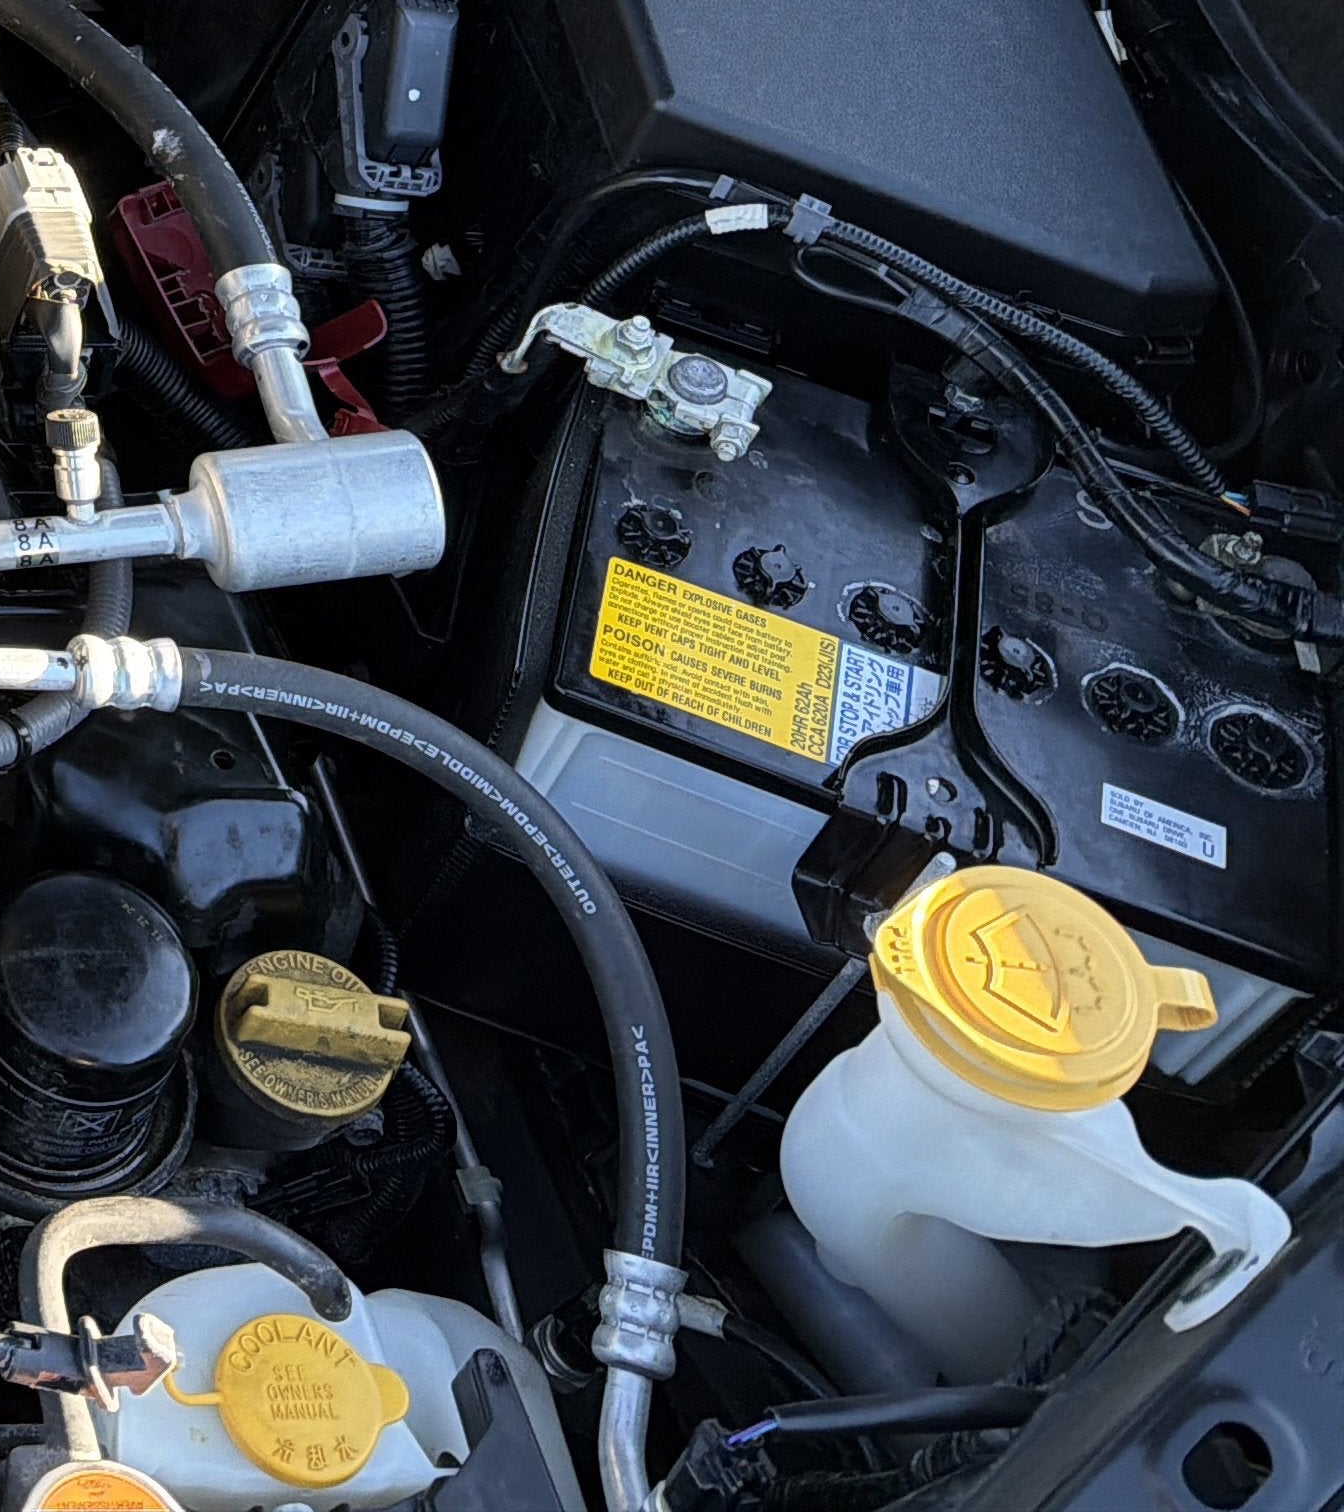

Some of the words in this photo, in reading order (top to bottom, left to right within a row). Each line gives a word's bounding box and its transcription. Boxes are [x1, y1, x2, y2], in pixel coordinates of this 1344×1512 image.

[18, 533, 32, 551] 8
[38, 532, 54, 549] A
[20, 554, 32, 567] 8
[39, 553, 54, 566] A
[613, 562, 678, 596] DANGER
[682, 589, 732, 615] EXPLOSIVE
[735, 608, 767, 628] GASES
[602, 623, 665, 657] POISON
[670, 650, 708, 673] CAUSES
[710, 665, 746, 687] SEVERE
[749, 679, 782, 700] BURNS
[617, 612, 641, 630] KEEP
[644, 622, 668, 640] VENT
[670, 631, 696, 650] CAPS
[697, 641, 725, 661] TIGHT
[728, 652, 749, 669] AND
[751, 661, 781, 681] LEVEL
[815, 635, 835, 691] D23(JIS)
[844, 648, 865, 691] START
[607, 668, 632, 686] KEEP
[634, 678, 654, 695] OUT
[656, 686, 669, 700] OF
[671, 691, 704, 713] REACH
[706, 704, 719, 719] OF
[721, 710, 771, 739] CHILDREN
[793, 678, 813, 717] 62Ah
[810, 692, 829, 728] 620A
[843, 691, 861, 703] &
[882, 665, 904, 731] トップ車用
[789, 713, 809, 751] 20HR
[839, 701, 860, 737] STOP
[807, 724, 826, 758] CCA
[1202, 840, 1214, 859] U
[245, 952, 324, 975] ENGINE
[239, 1049, 266, 1078] SEE
[331, 1074, 383, 1108] MANUAL
[228, 1320, 356, 1372] COOLANT
[273, 1364, 307, 1382] SEE
[270, 1403, 339, 1421] MANUAL
